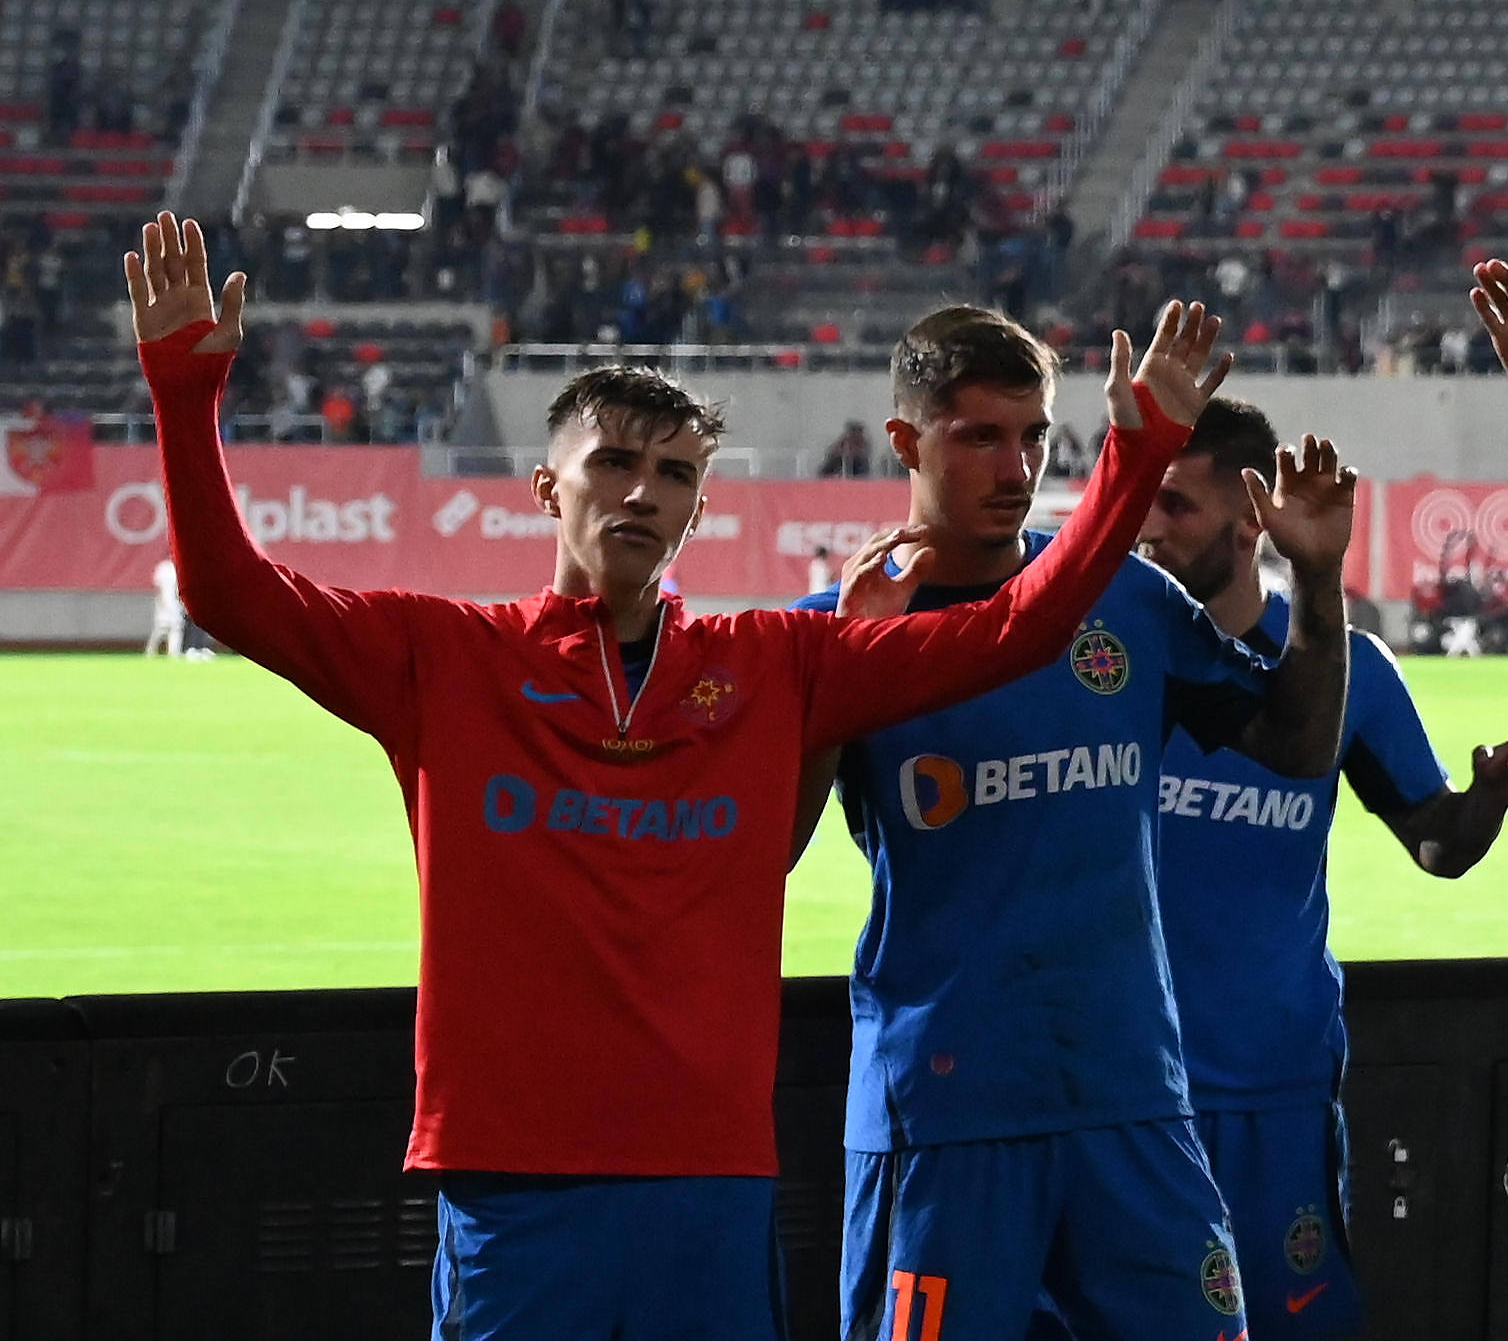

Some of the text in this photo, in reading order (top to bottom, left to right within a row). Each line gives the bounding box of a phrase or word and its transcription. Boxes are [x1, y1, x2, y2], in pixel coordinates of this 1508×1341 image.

[973, 741, 1141, 807] BETANO
[547, 788, 739, 841] BETANO
[1158, 775, 1315, 830] BETANO
[225, 1048, 296, 1088] OK
